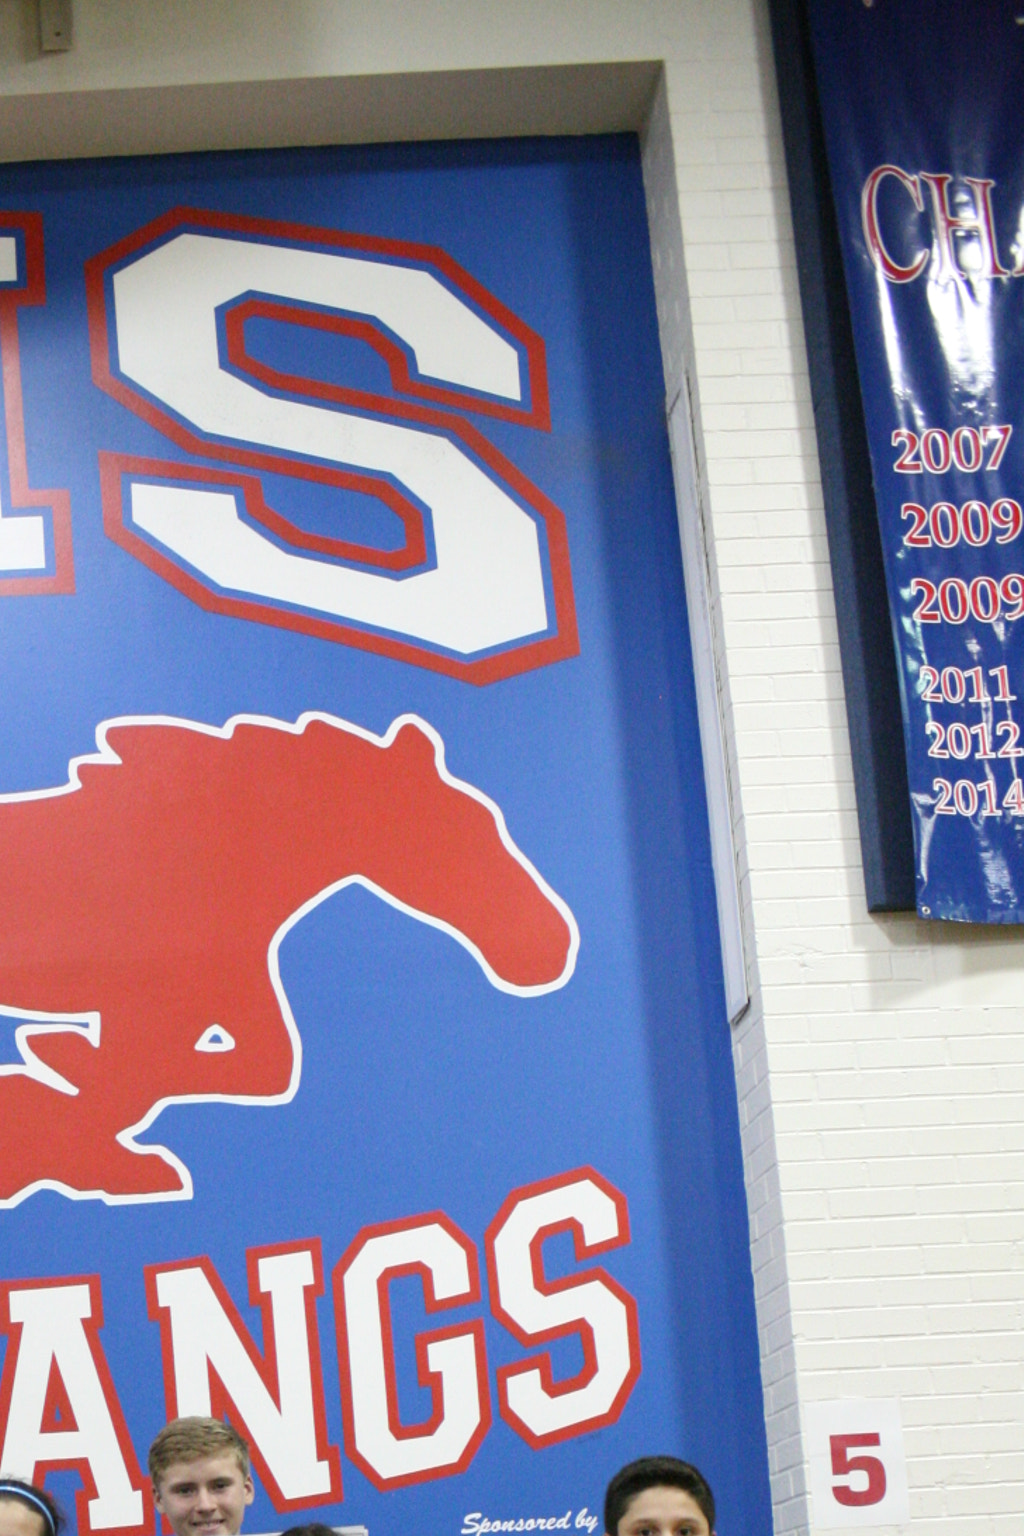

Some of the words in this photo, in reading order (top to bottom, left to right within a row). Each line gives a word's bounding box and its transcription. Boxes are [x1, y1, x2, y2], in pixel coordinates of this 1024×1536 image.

[860, 164, 1024, 284] CH
[891, 425, 1012, 474] 2007
[901, 498, 1022, 548] 2009
[911, 574, 1024, 624] 2009
[919, 665, 1017, 704] 2011
[925, 721, 1024, 760] 2012
[933, 778, 1024, 817] 2014
[829, 1432, 887, 1507] 5
[574, 1507, 598, 1534] by
